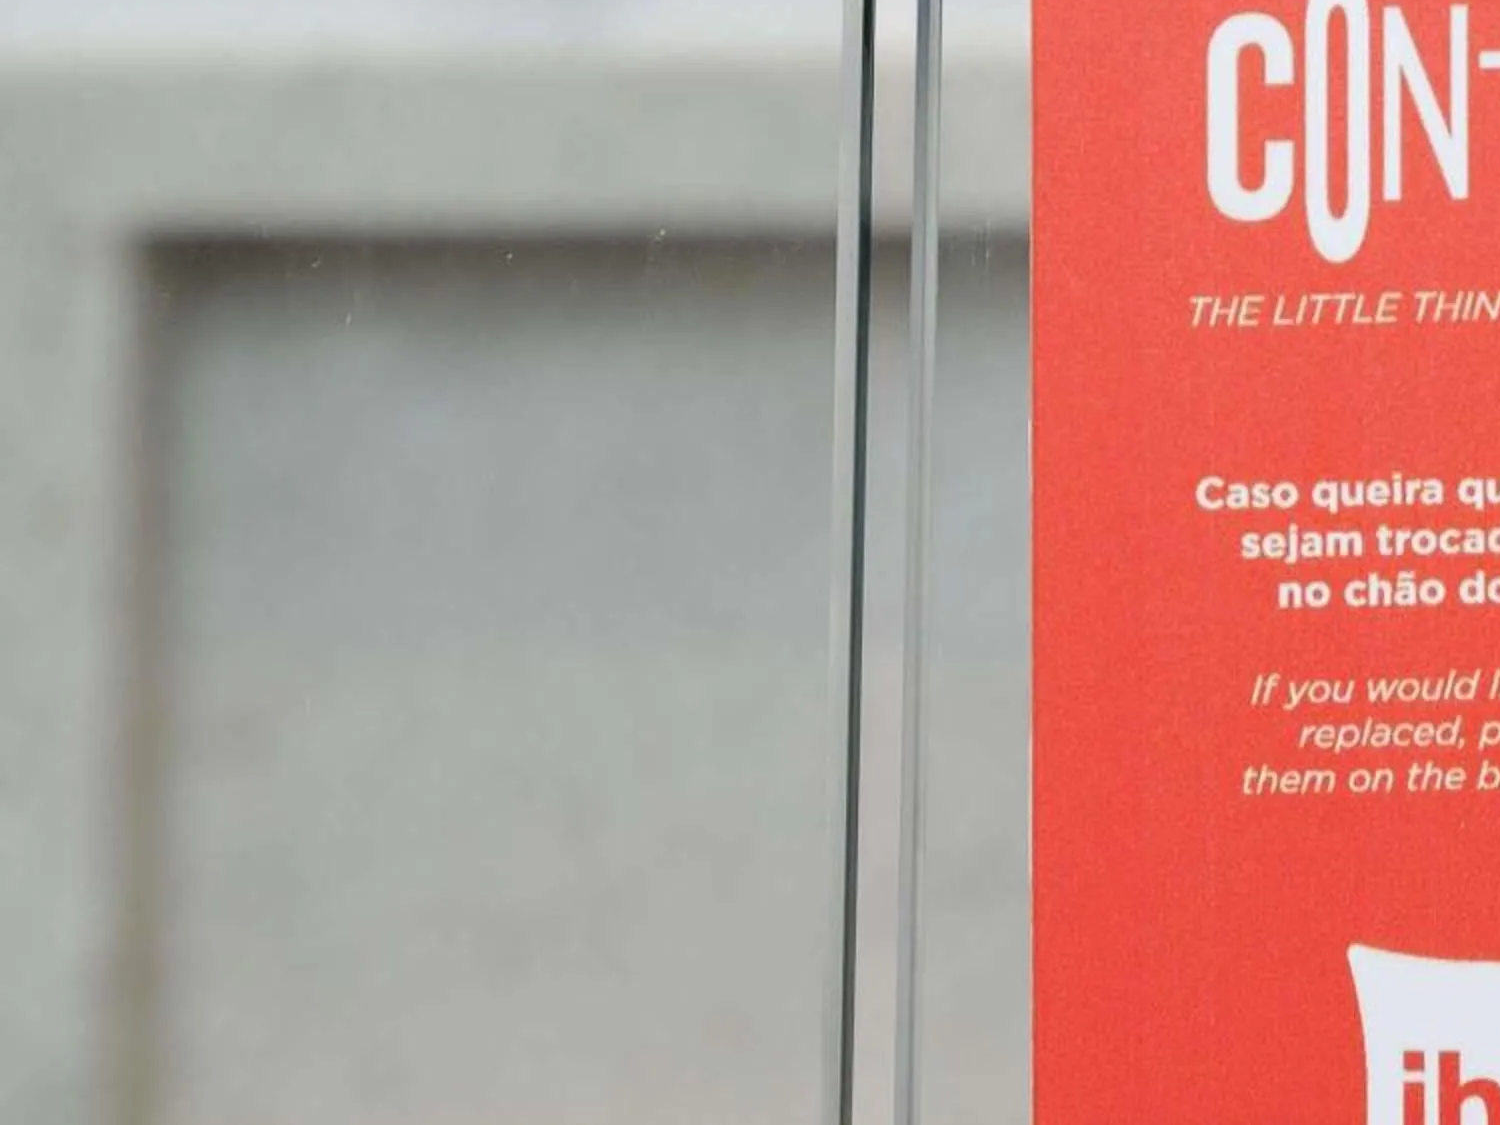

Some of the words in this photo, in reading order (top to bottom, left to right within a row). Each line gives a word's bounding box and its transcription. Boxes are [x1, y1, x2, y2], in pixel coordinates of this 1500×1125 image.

[1189, 295, 1265, 327] THE
[1272, 291, 1403, 326] LITTLE
[1195, 475, 1300, 511] Caso
[1311, 472, 1445, 514] queira
[1240, 522, 1364, 565] sejam
[1277, 580, 1332, 609] no
[1343, 570, 1447, 608] chão
[1251, 673, 1280, 705] If
[1283, 680, 1355, 710] you
[1367, 669, 1481, 703] would
[1299, 715, 1465, 753] replaced,
[1243, 764, 1336, 795] them
[1348, 768, 1394, 793] on
[1407, 761, 1467, 792] the
